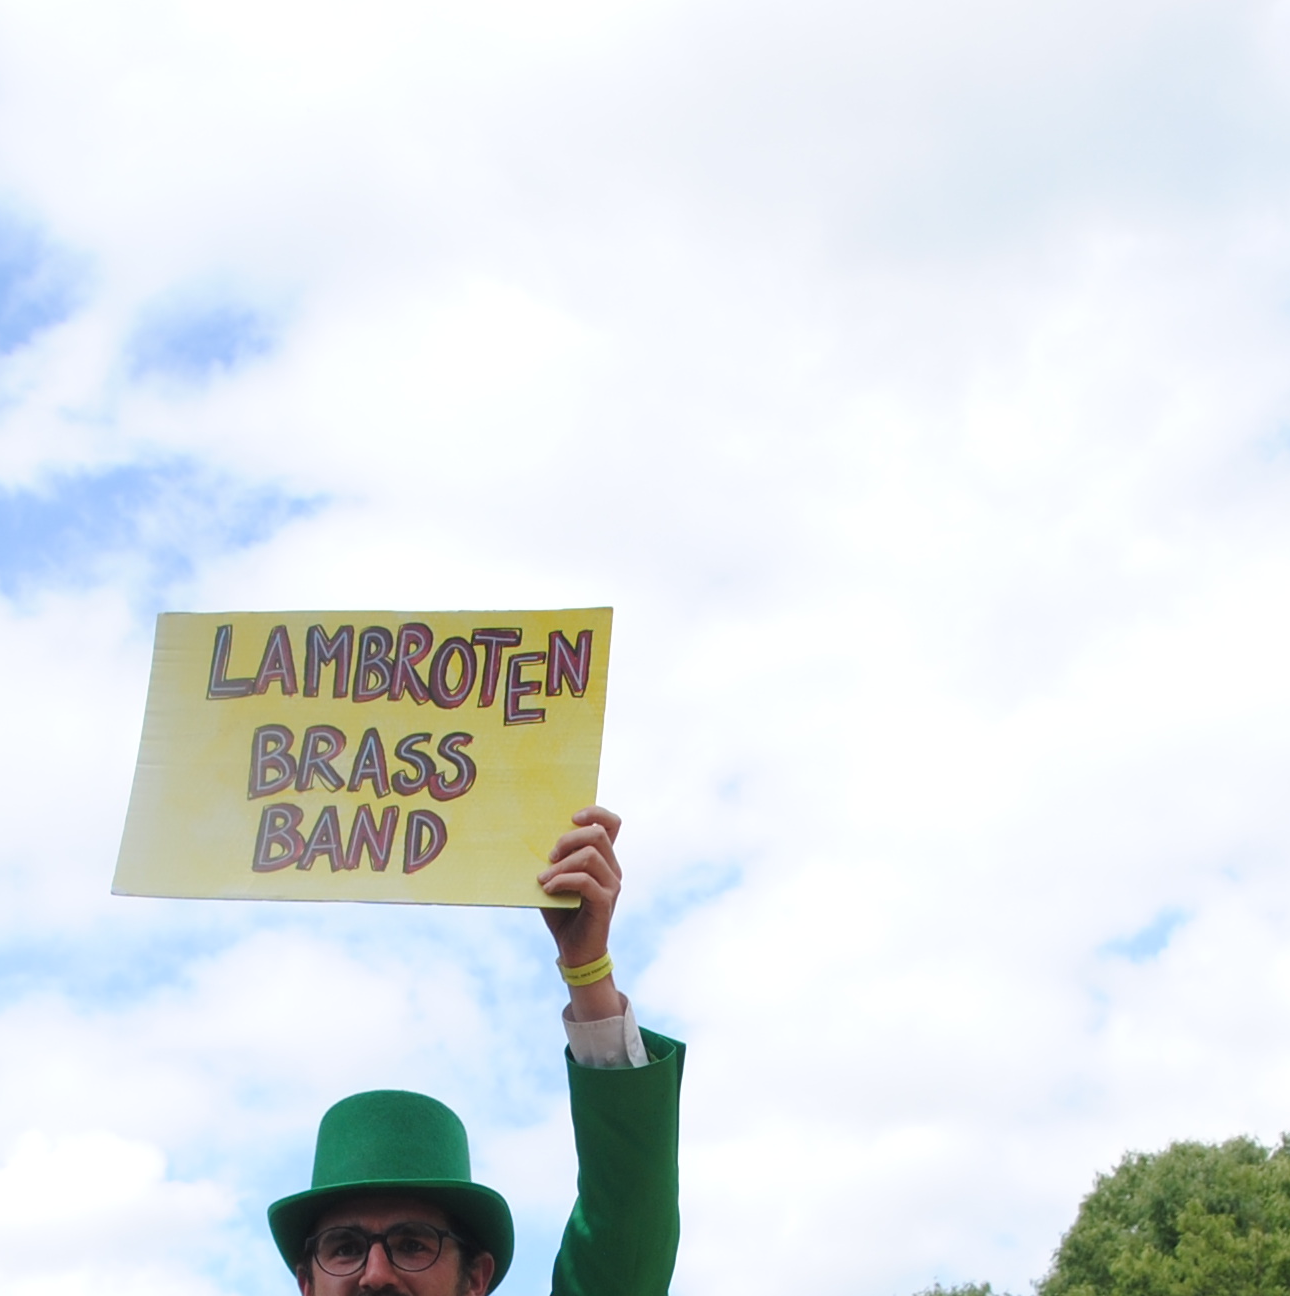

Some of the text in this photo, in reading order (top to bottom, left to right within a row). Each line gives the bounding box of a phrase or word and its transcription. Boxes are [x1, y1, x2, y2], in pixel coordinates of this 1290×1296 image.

[206, 622, 593, 726] LAMBROTEN
[247, 724, 477, 801] BRASS
[252, 802, 447, 874] BAND
